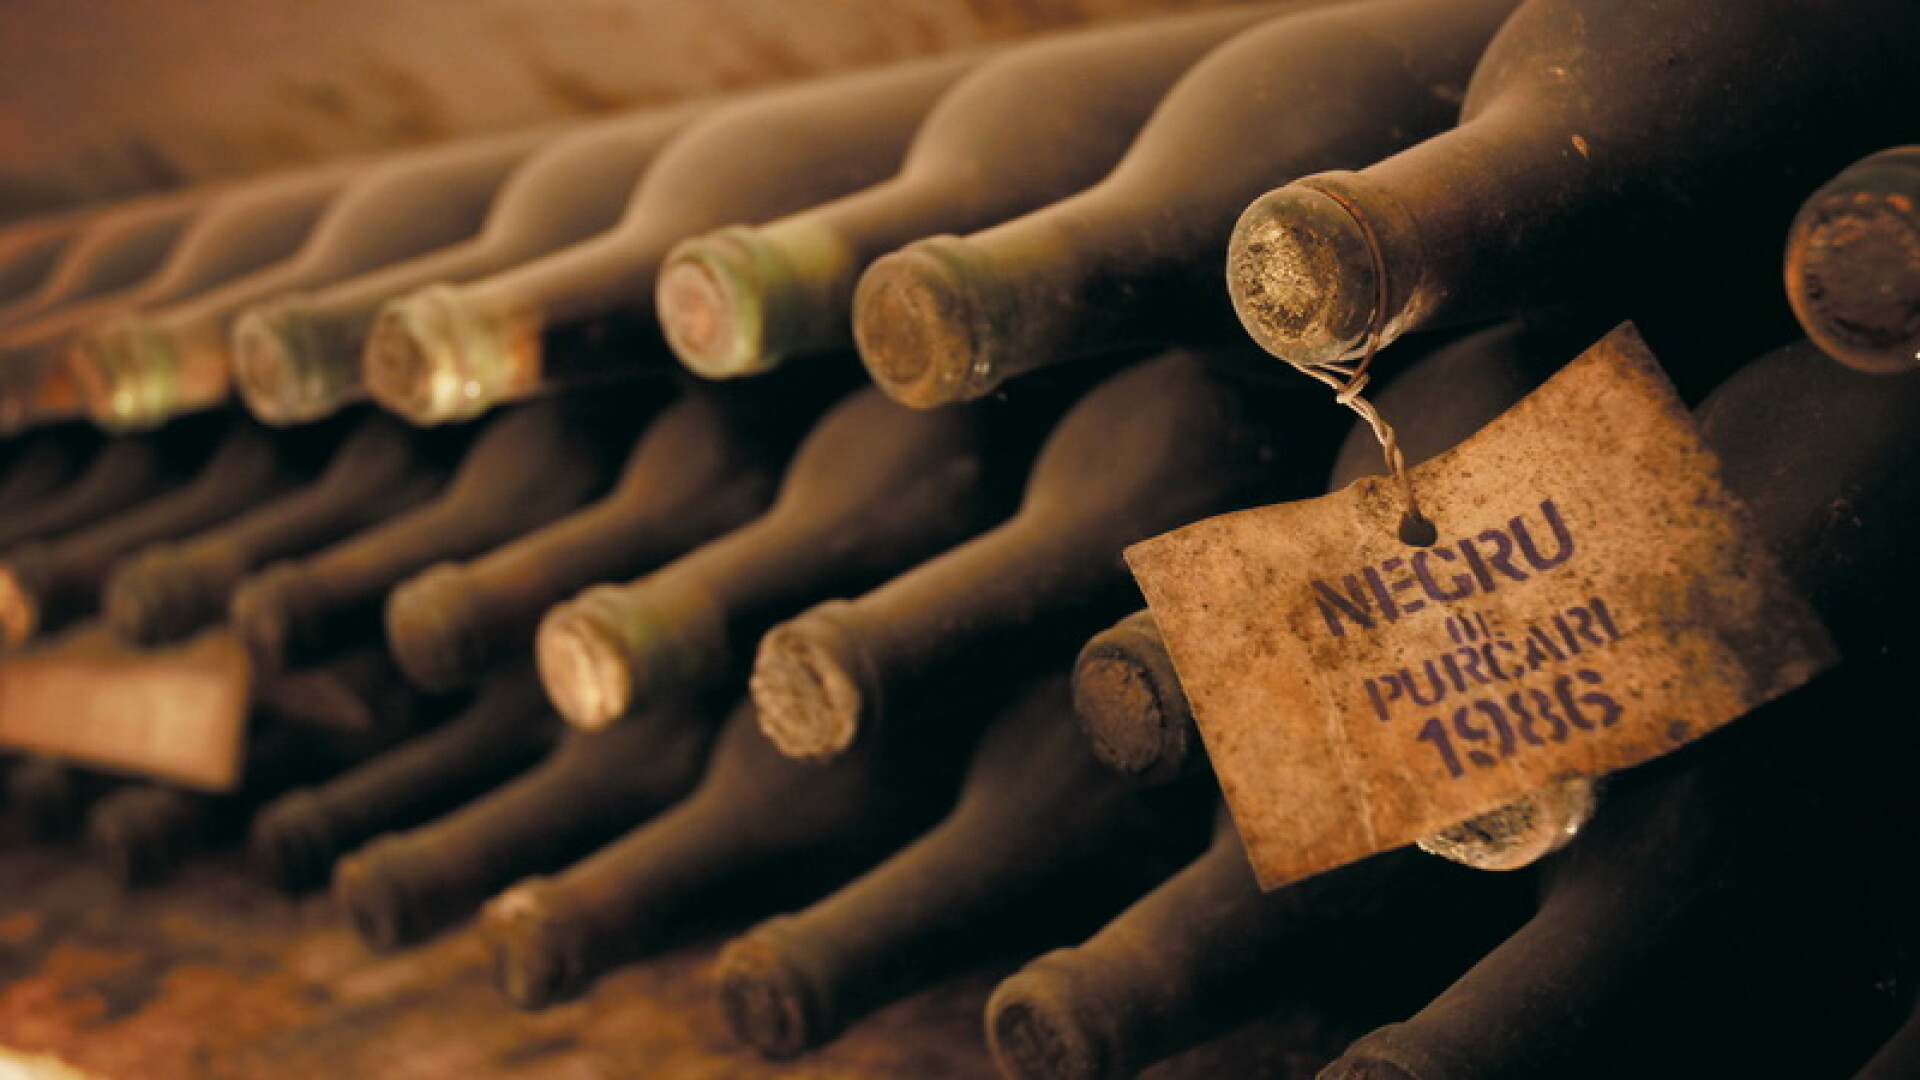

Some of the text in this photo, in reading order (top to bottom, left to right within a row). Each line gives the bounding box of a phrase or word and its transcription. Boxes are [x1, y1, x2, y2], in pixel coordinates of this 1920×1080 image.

[1312, 500, 1575, 636] NEGRU
[1364, 597, 1620, 721] PURCARI
[1418, 669, 1623, 778] 1986
